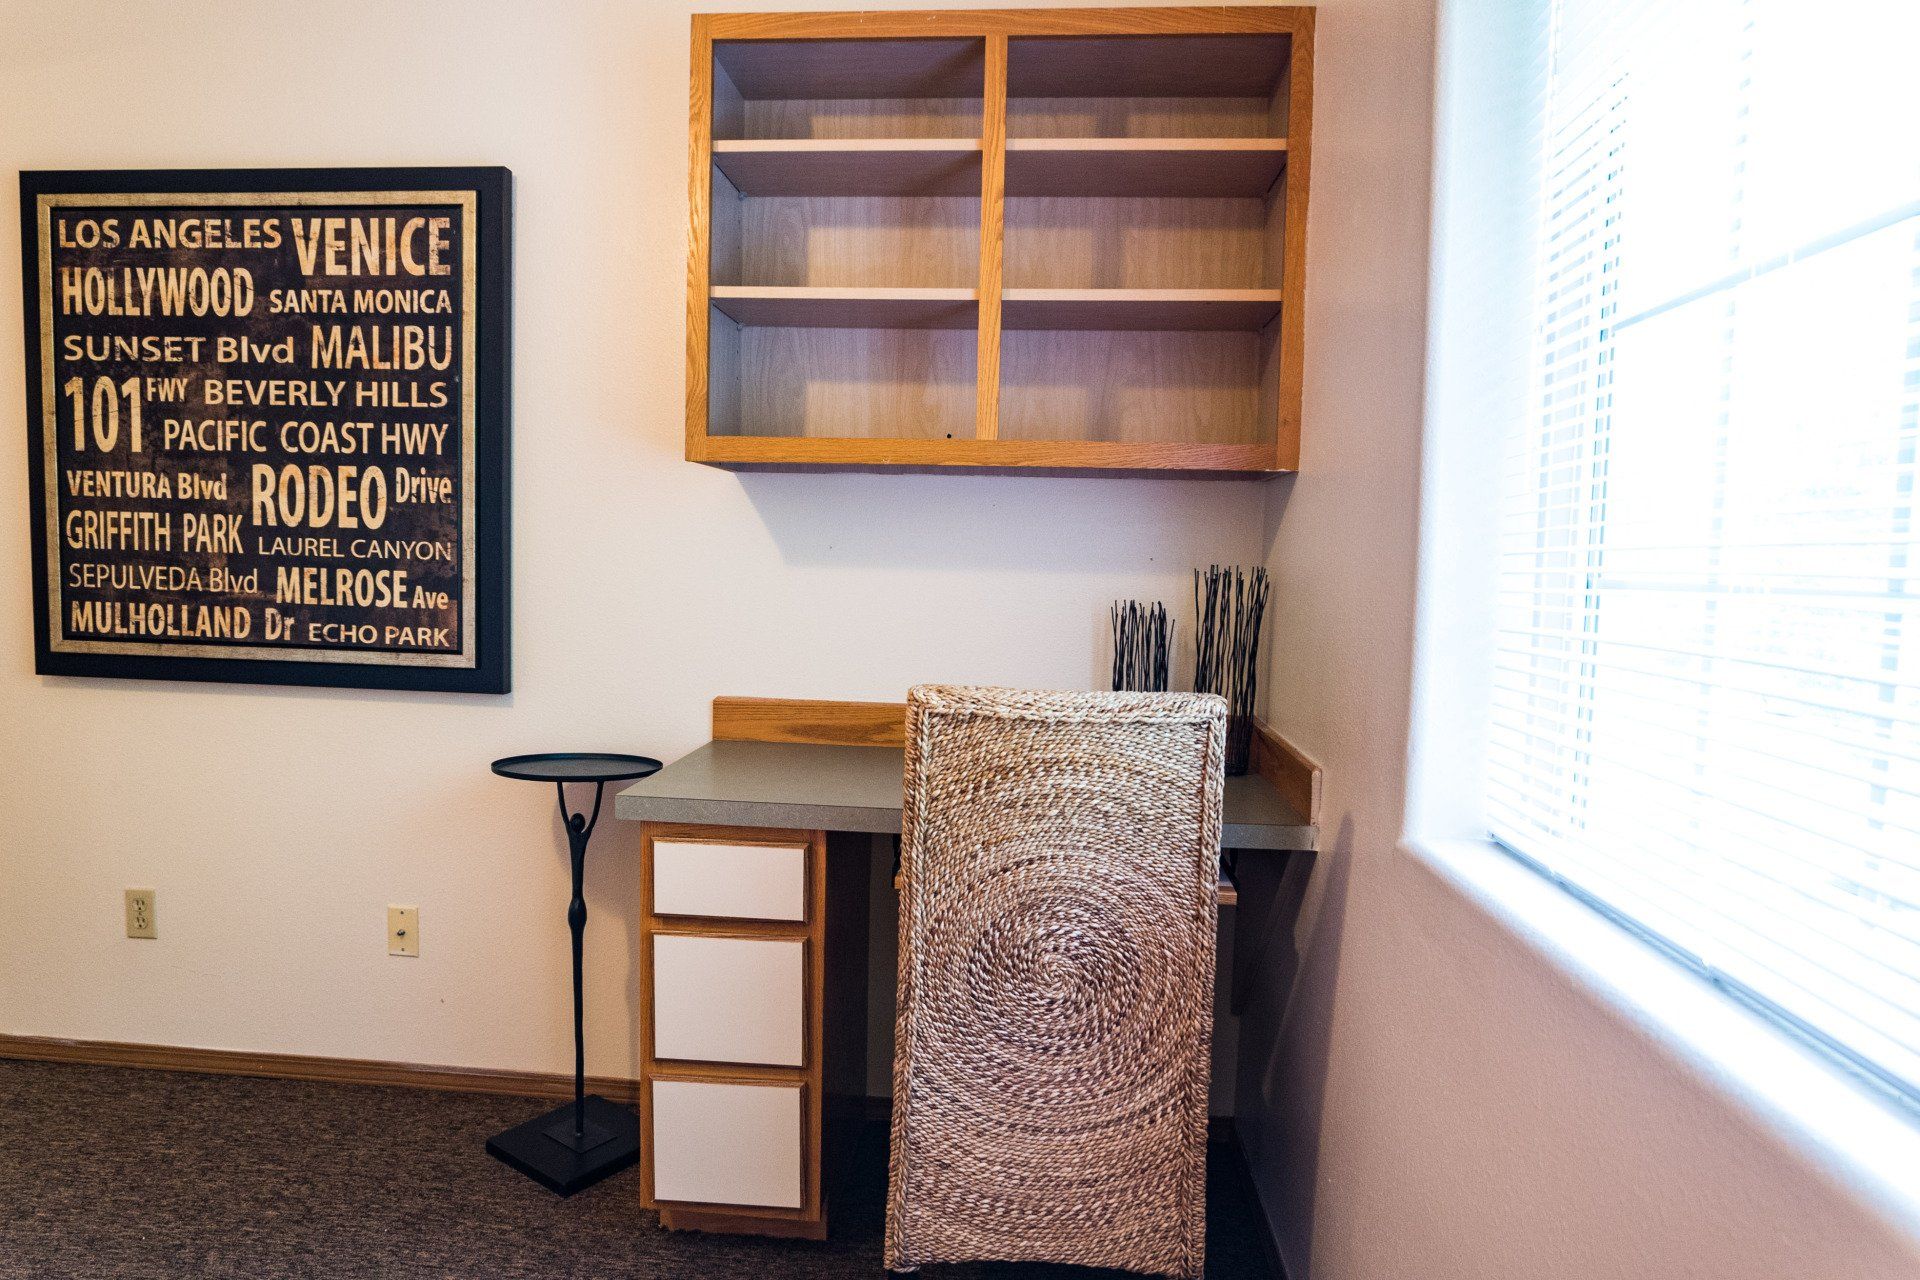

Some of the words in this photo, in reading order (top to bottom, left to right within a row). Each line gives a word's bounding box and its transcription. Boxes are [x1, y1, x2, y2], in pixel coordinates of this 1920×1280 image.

[59, 219, 121, 249] LOS
[129, 218, 282, 249] ANGELES
[291, 217, 451, 276] VENICE
[62, 267, 254, 317] HOLLYWOOD
[270, 289, 347, 314] SANTA
[353, 289, 452, 314] MONICA
[64, 336, 206, 363] SUNSET
[218, 336, 294, 364] Blvd
[311, 325, 452, 371] MALIBU
[205, 380, 346, 407] BEVERLY
[356, 381, 449, 408] HILLS
[64, 376, 142, 454] 101
[147, 378, 189, 402] FWY
[164, 419, 267, 452] PACIFIC
[280, 421, 374, 454] COAST
[381, 423, 449, 455] HWY
[66, 470, 172, 499] VENTURA
[178, 472, 228, 501] Blvd
[252, 464, 387, 530] RODEO
[395, 467, 452, 505] Drive
[66, 509, 171, 551] GRIFFITH
[183, 513, 244, 554] PARK
[258, 536, 345, 558] LAUREL
[351, 539, 451, 561] CANYON
[69, 563, 203, 591] SEPULVEDA
[209, 567, 258, 594] Blvd
[276, 566, 408, 608] MELROSE
[412, 585, 449, 610] Ave
[71, 601, 251, 640] MULHOLLAND
[265, 613, 295, 641] Dr
[309, 623, 377, 644] ECHO
[385, 626, 450, 647] PARK
